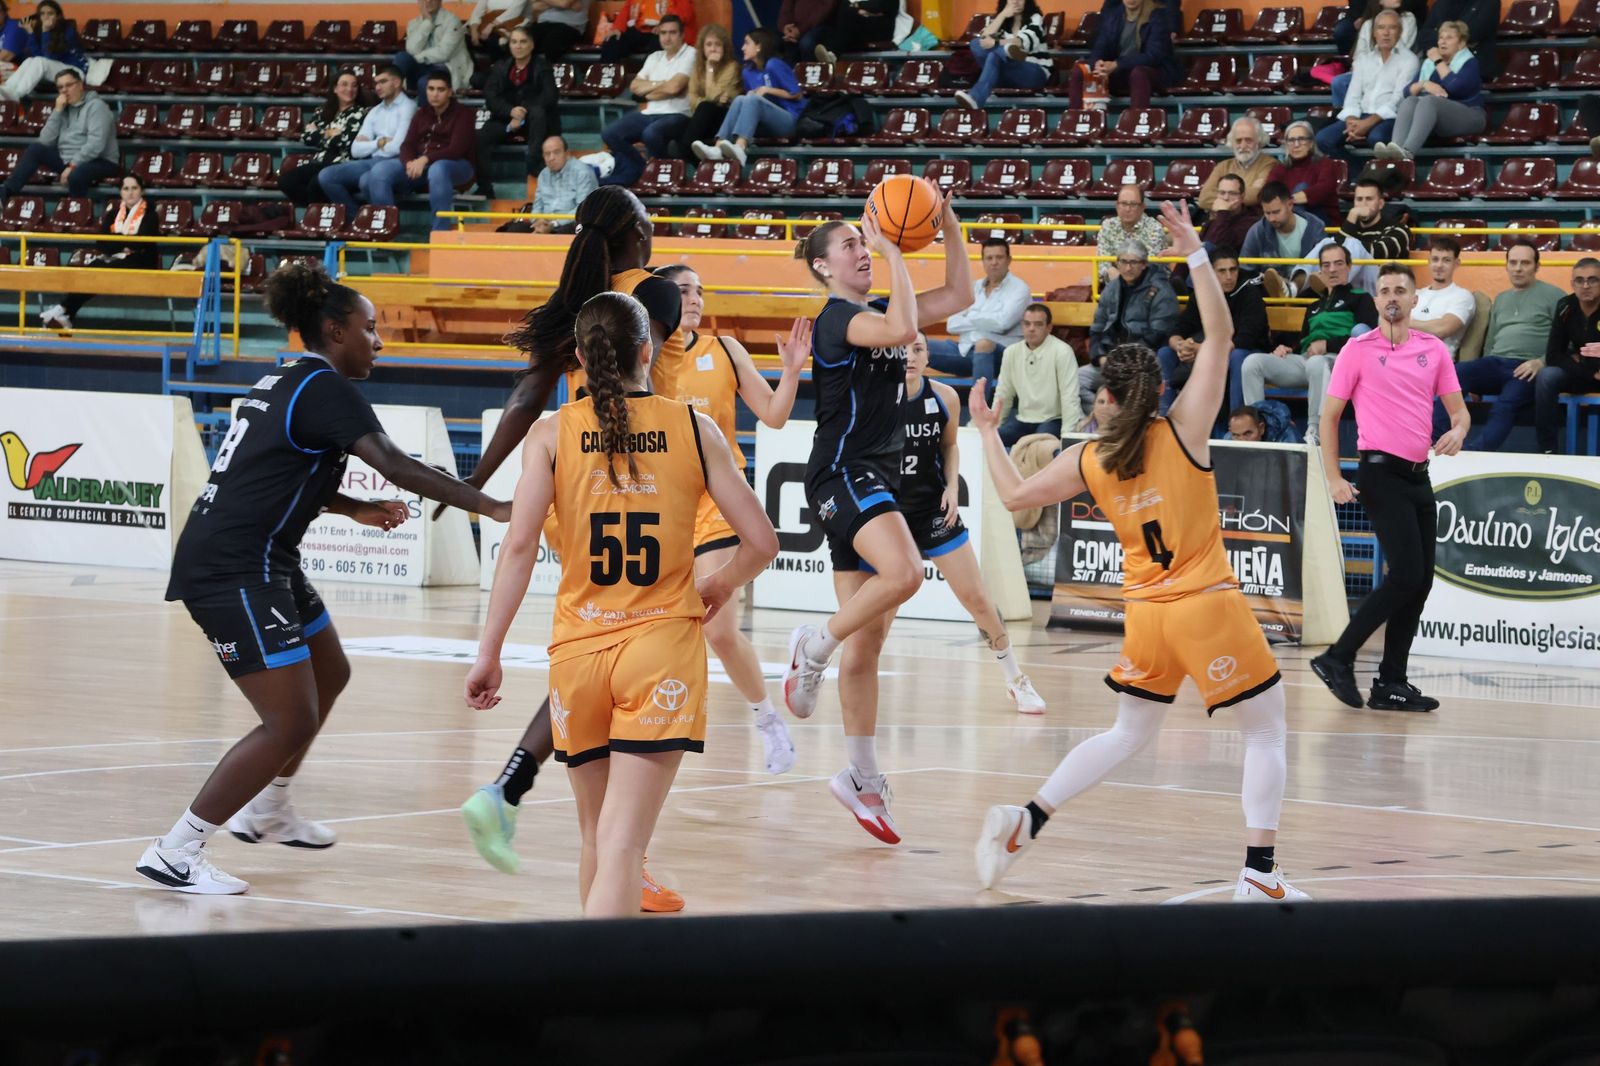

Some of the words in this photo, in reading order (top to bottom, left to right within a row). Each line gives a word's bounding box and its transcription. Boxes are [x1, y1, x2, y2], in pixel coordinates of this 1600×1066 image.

[1524, 162, 1535, 176] 7
[32, 470, 164, 509] VALDERADUEY
[8, 505, 17, 516] EL
[19, 506, 52, 519] CENTRO
[56, 508, 107, 523] COMERCIAL
[111, 513, 122, 523] DE
[126, 513, 164, 527] ZAMORA
[1218, 508, 1291, 533] HÓN
[319, 527, 328, 535] 17
[330, 527, 347, 536] Entr
[361, 529, 385, 539] 49008
[387, 530, 418, 541] Zamora
[589, 511, 661, 587] 55
[1141, 519, 1174, 570] 4
[312, 558, 325, 571] 90
[336, 560, 356, 574] 605
[360, 561, 374, 575] 76
[377, 562, 389, 575] 71
[393, 564, 408, 577] 05
[766, 558, 825, 573] IMNASIO
[1464, 563, 1526, 579] Embutidos
[1528, 570, 1537, 583] y
[1538, 569, 1593, 584] Jamones
[1239, 583, 1285, 596] IMITES
[679, 714, 695, 723] PLA
